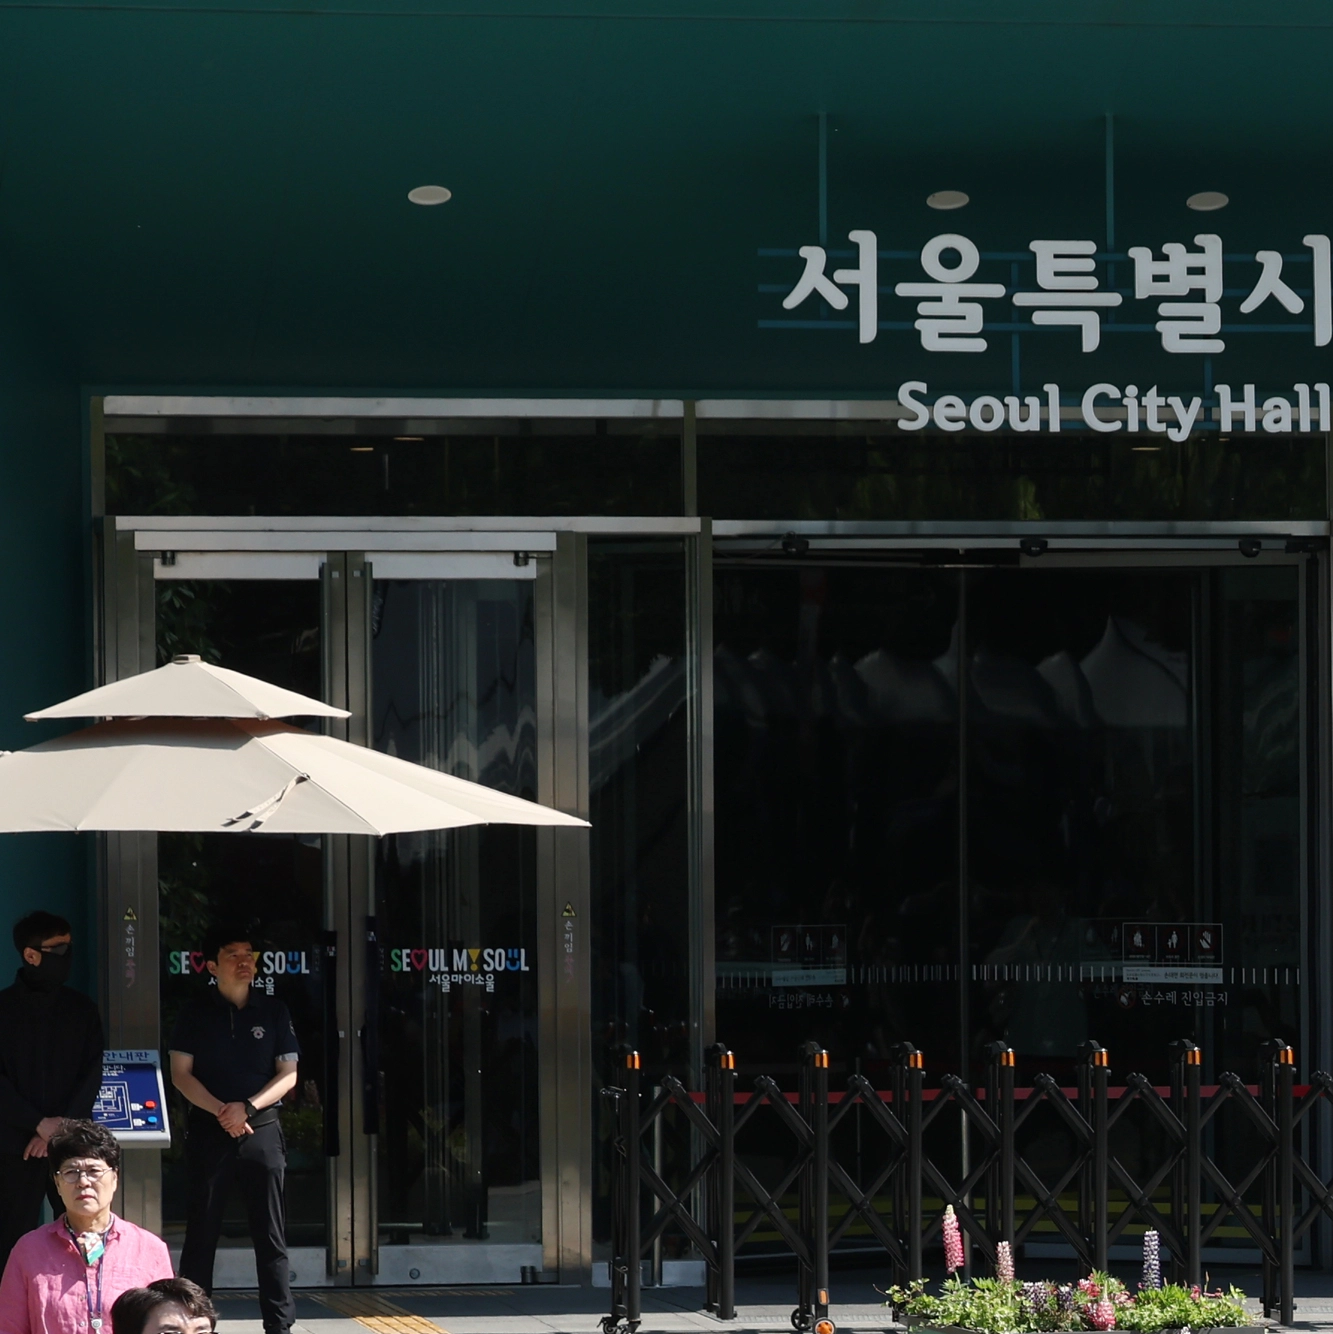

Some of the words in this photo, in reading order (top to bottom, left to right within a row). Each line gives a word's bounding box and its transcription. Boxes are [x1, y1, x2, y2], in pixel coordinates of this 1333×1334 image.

[897, 381, 1062, 433] Seoul
[1082, 382, 1202, 442] City
[1216, 383, 1332, 433] Hall
[429, 973, 495, 992] 서울마이소울
[1141, 990, 1177, 1006] 손수레
[1181, 990, 1228, 1007] 진입금지
